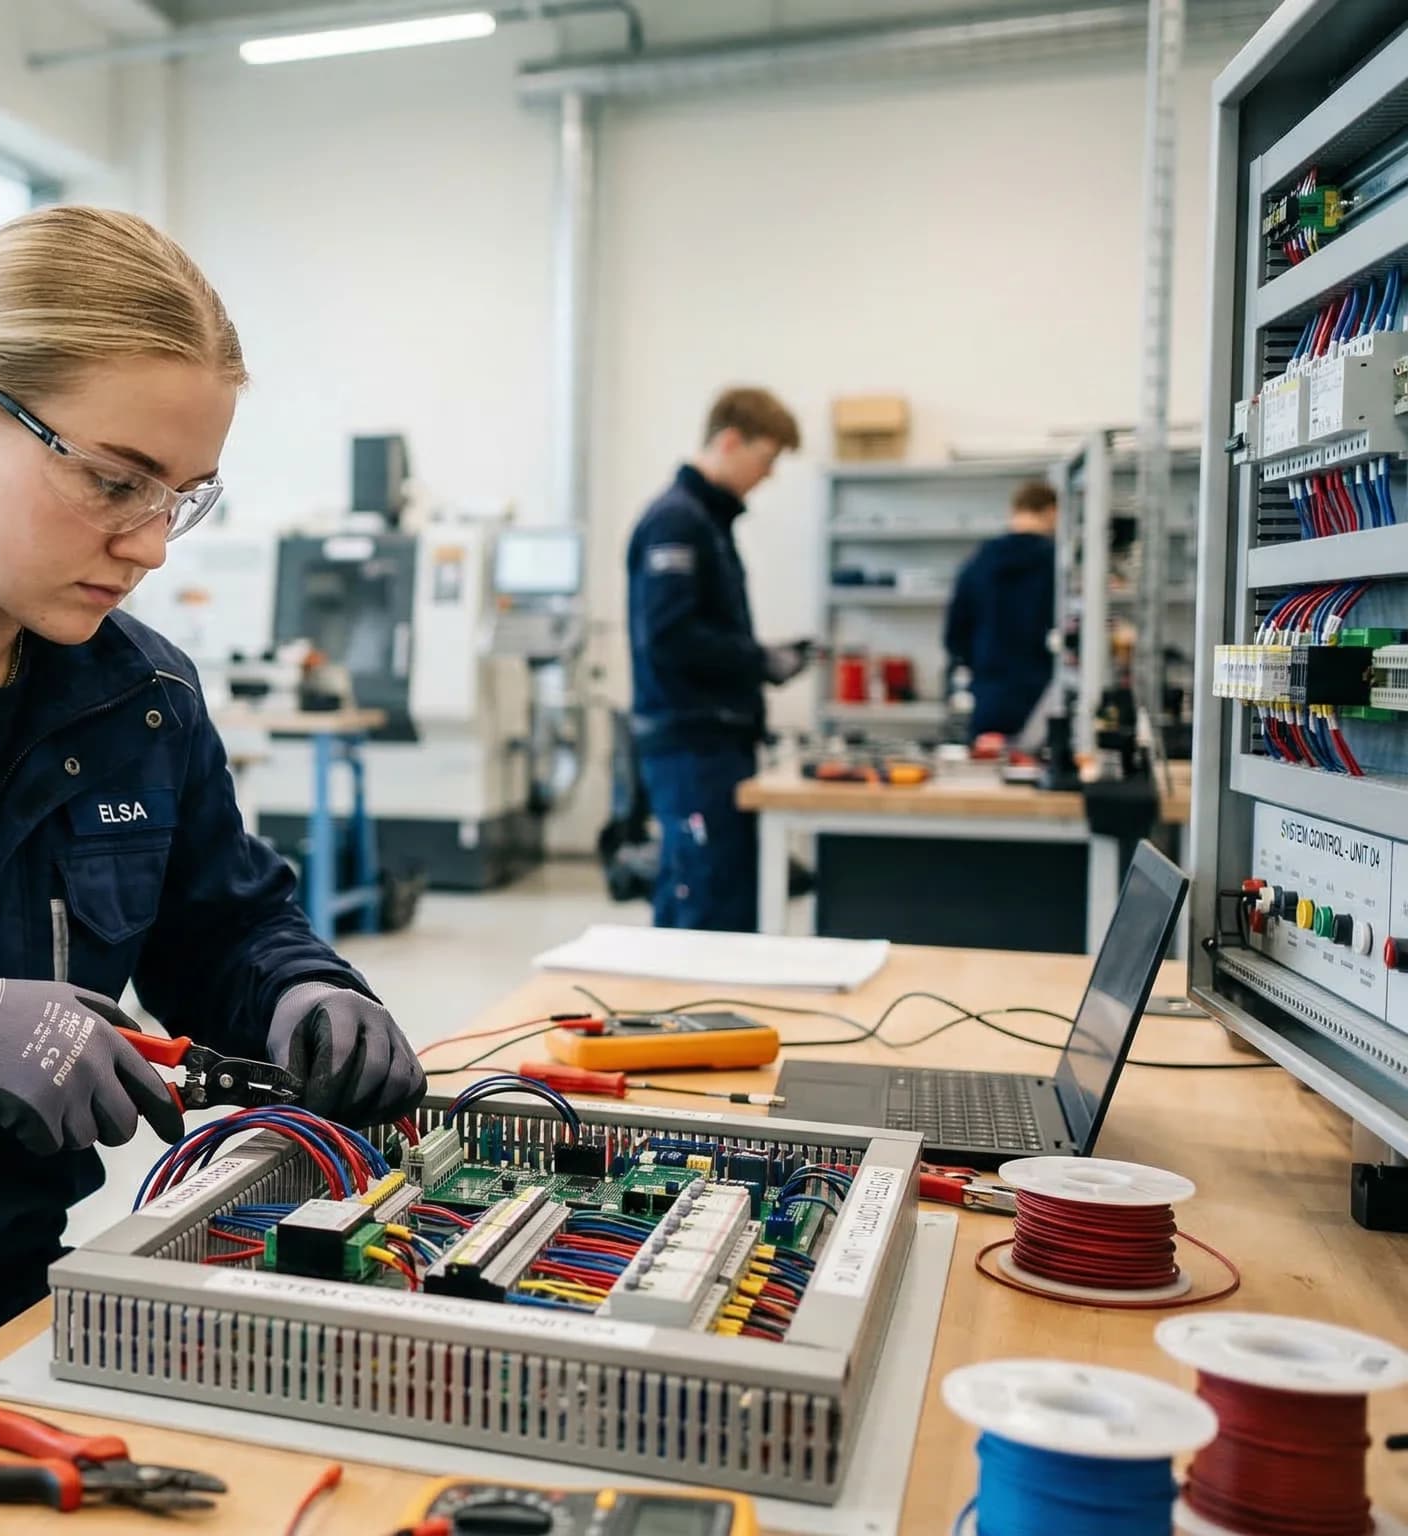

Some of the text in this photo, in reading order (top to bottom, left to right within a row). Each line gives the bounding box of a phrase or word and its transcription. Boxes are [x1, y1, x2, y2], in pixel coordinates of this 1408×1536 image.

[98, 801, 148, 823] ELSA
[1281, 819, 1308, 845] SYSTEM
[1309, 828, 1344, 857] CONTROL
[1350, 840, 1369, 864] UNIT
[1370, 847, 1380, 868] 04
[231, 1276, 339, 1298] SYSTEM
